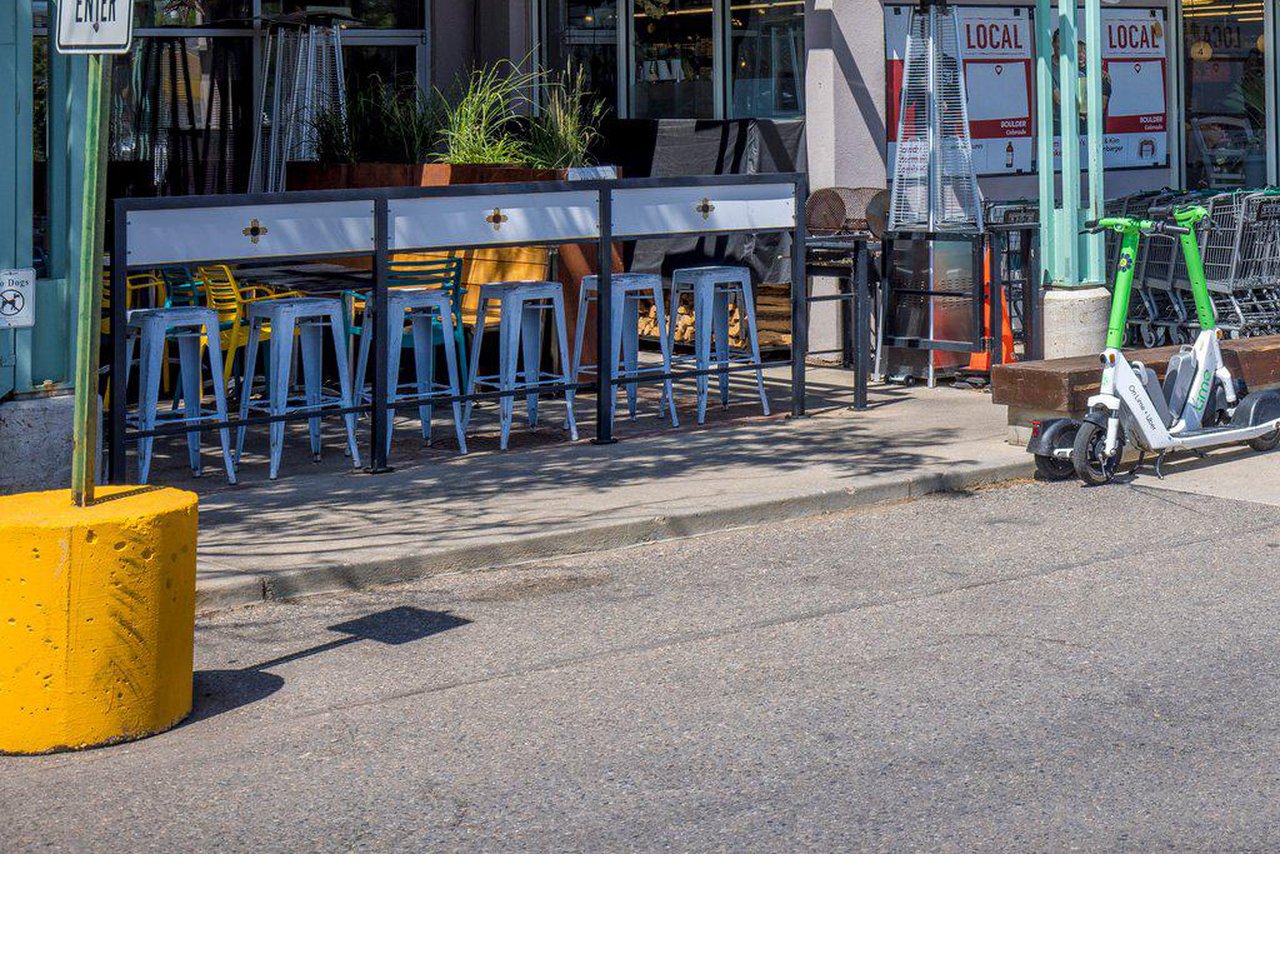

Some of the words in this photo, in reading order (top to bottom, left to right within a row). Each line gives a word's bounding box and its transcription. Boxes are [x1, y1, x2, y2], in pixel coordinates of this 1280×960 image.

[966, 23, 1023, 50] LOCAL
[1108, 24, 1159, 49] LOCAL
[1000, 120, 1027, 129] BOULDER
[8, 279, 29, 288] Dogs
